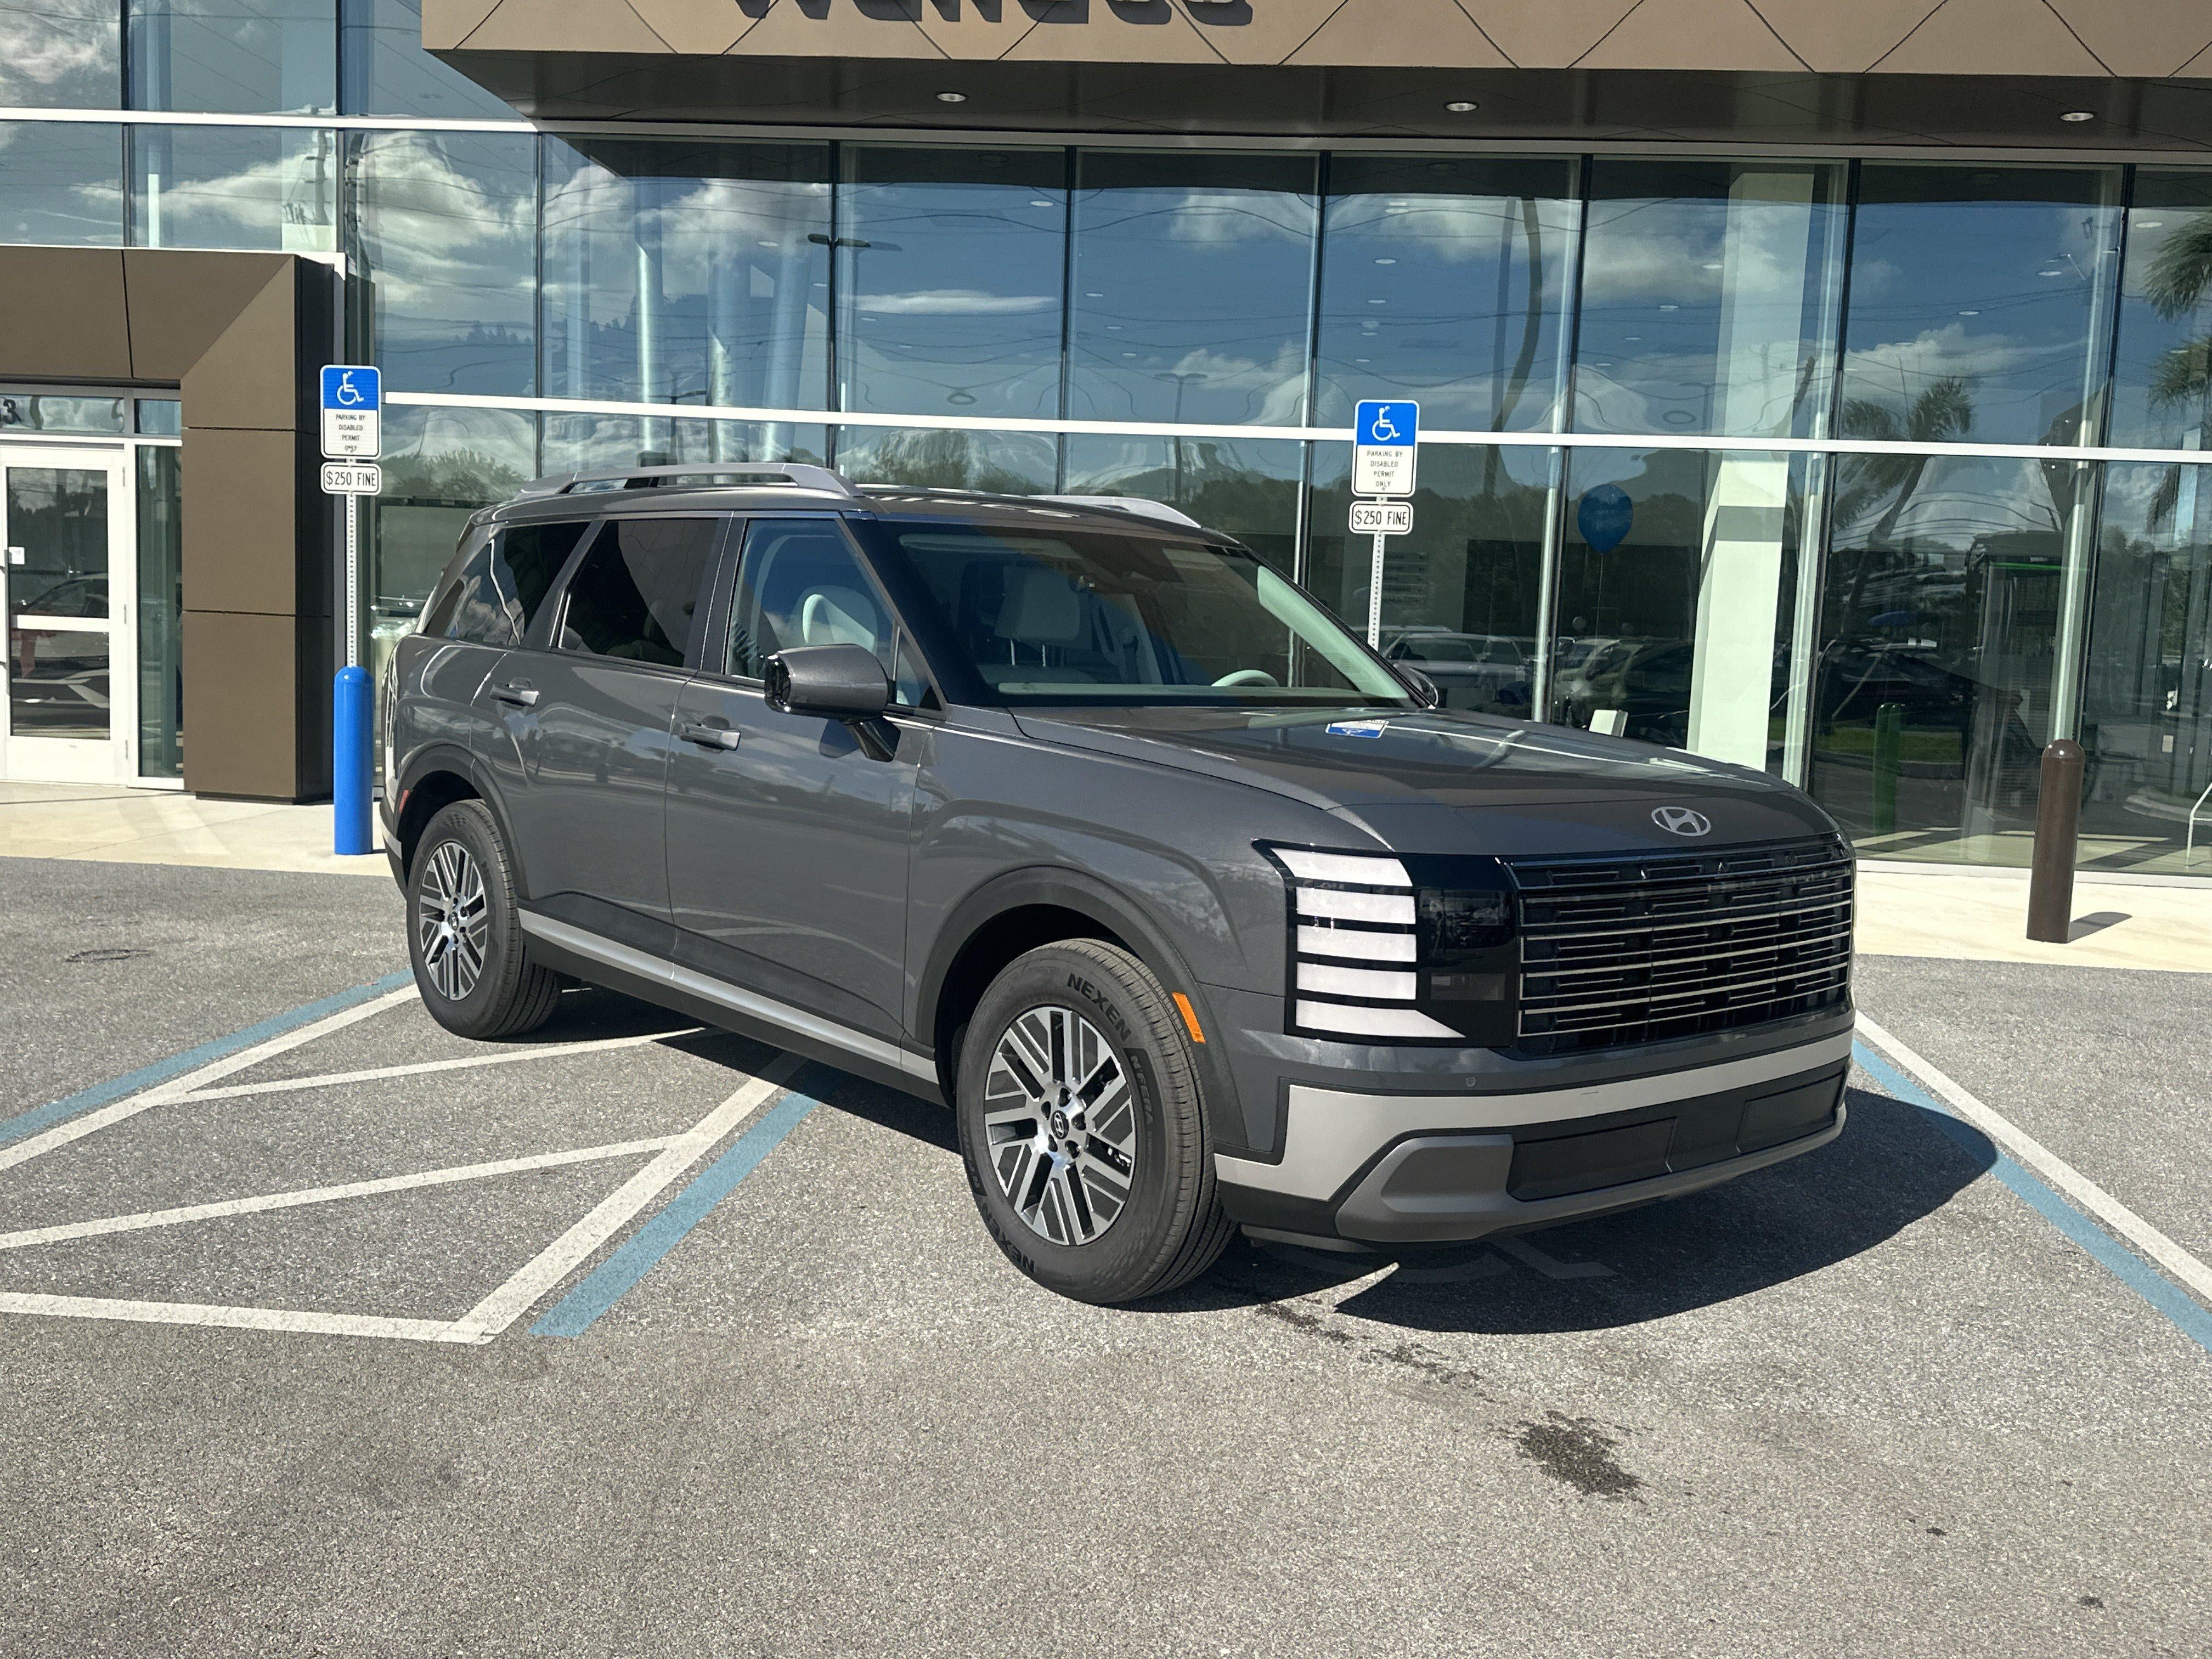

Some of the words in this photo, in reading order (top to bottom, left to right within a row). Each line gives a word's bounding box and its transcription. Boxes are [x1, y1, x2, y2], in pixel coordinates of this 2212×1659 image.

[326, 471, 352, 486] $250
[357, 472, 376, 486] FINE
[1355, 510, 1381, 525] $250
[1387, 511, 1407, 525] FINE
[1066, 973, 1132, 1041] NEXEN
[981, 1202, 1035, 1273] NEXEN
